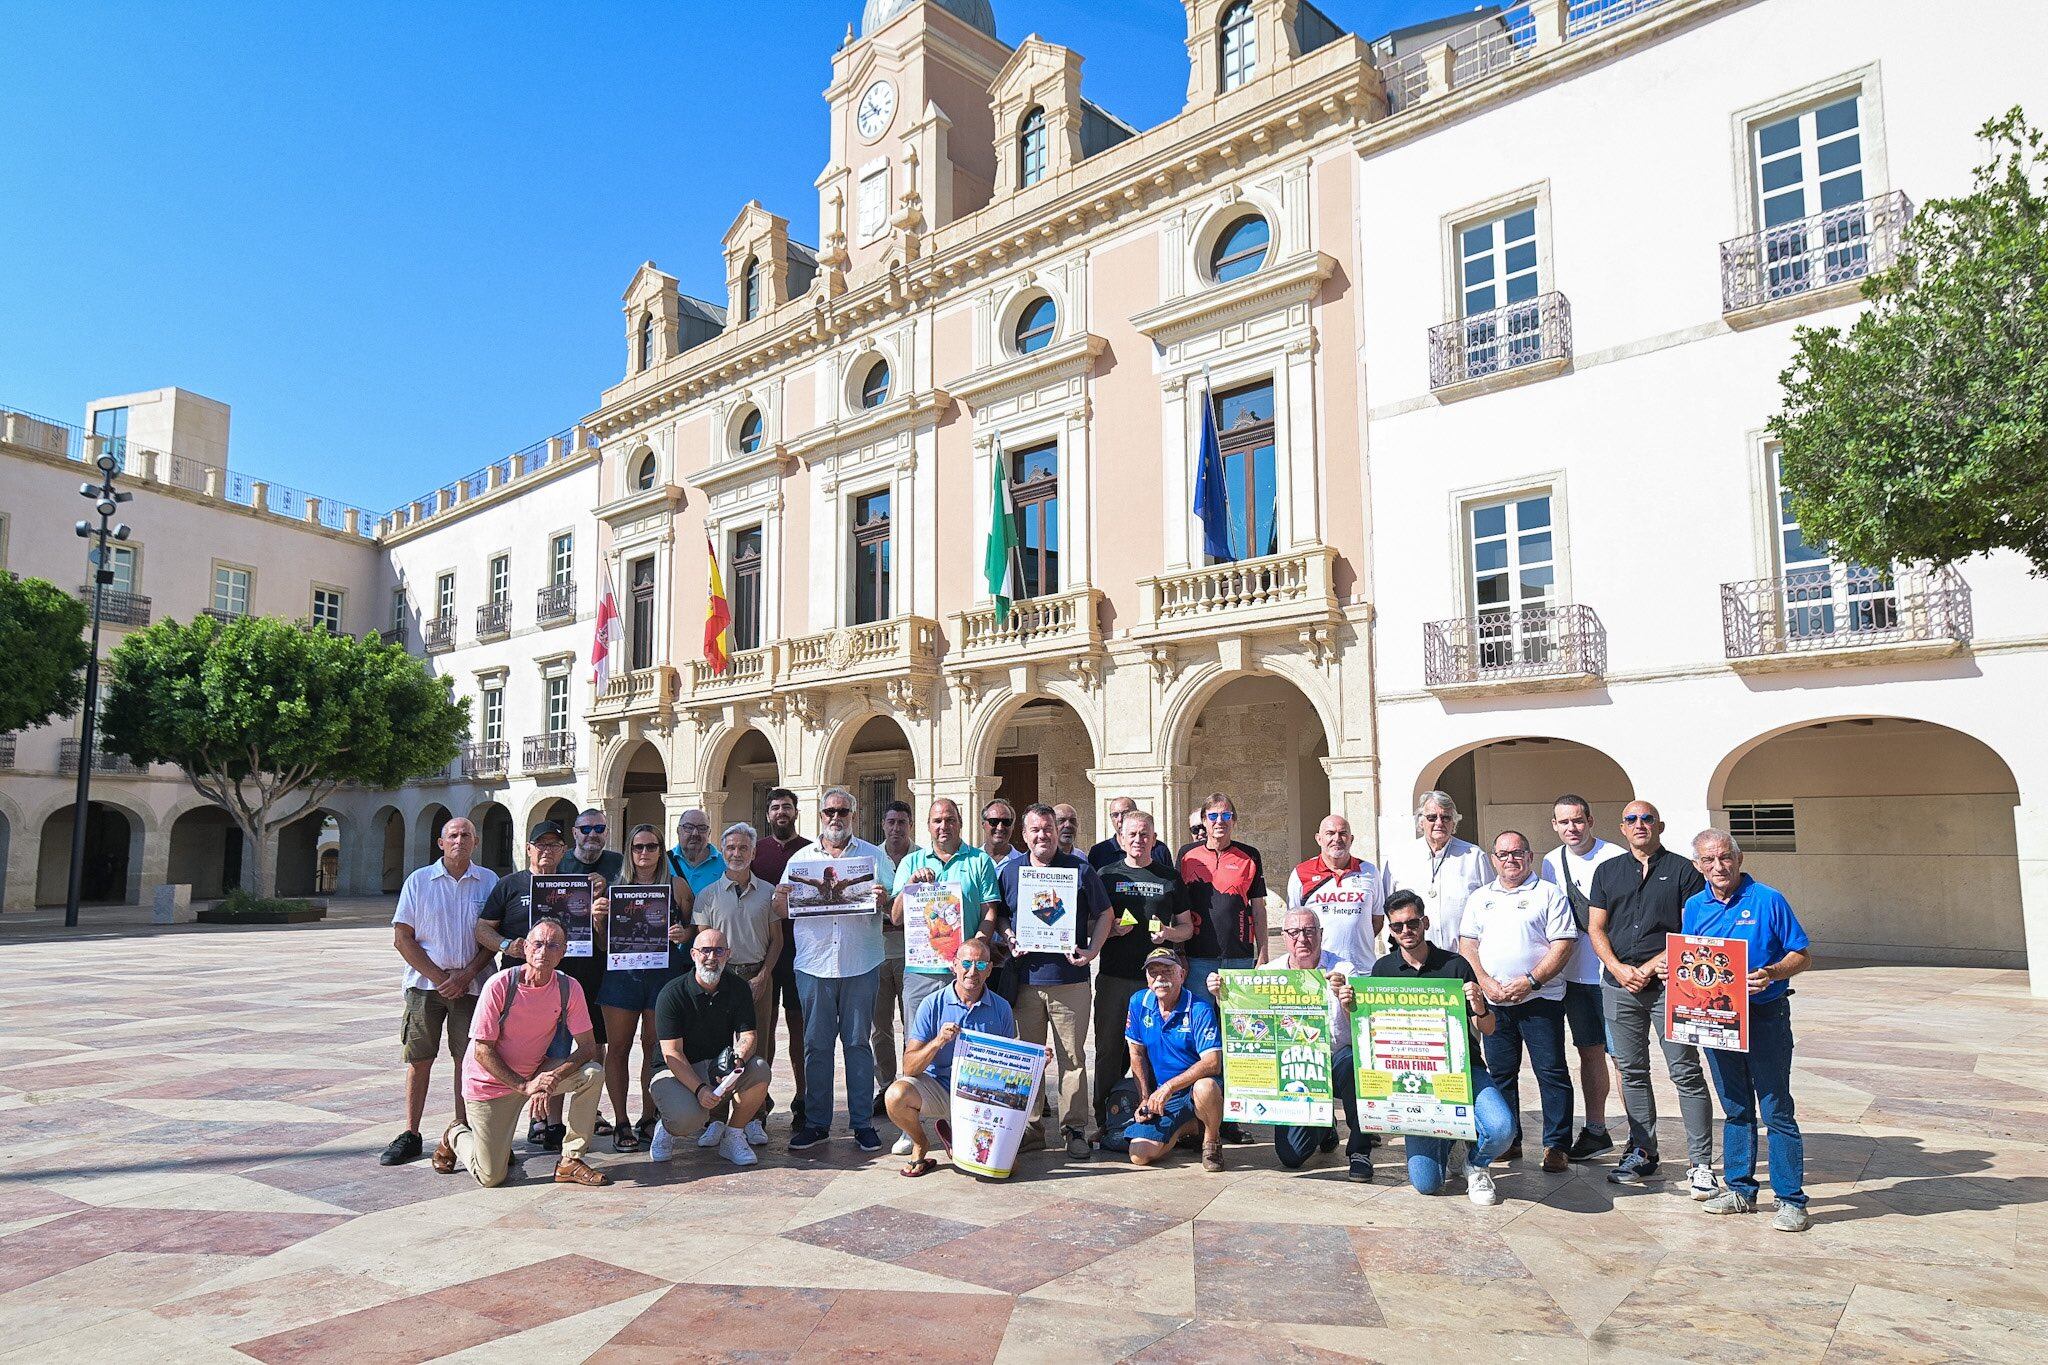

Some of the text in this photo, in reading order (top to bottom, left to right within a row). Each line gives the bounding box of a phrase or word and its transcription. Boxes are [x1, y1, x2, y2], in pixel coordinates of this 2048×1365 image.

[1315, 892, 1364, 903] NACEX
[1235, 975, 1288, 985] TROFEO
[1254, 985, 1296, 995] FERIA
[1269, 995, 1321, 1004] SENIOR
[1356, 993, 1459, 1006] JUAN ONCALA
[1281, 1046, 1325, 1067] GRAN
[988, 1058, 1008, 1066] Deportivos
[1009, 1062, 1030, 1070] Municipales
[1385, 1060, 1438, 1071] GRAN FINAL
[960, 1062, 1033, 1087] VOLEY PLAYA
[1281, 1063, 1326, 1081] FINAL
